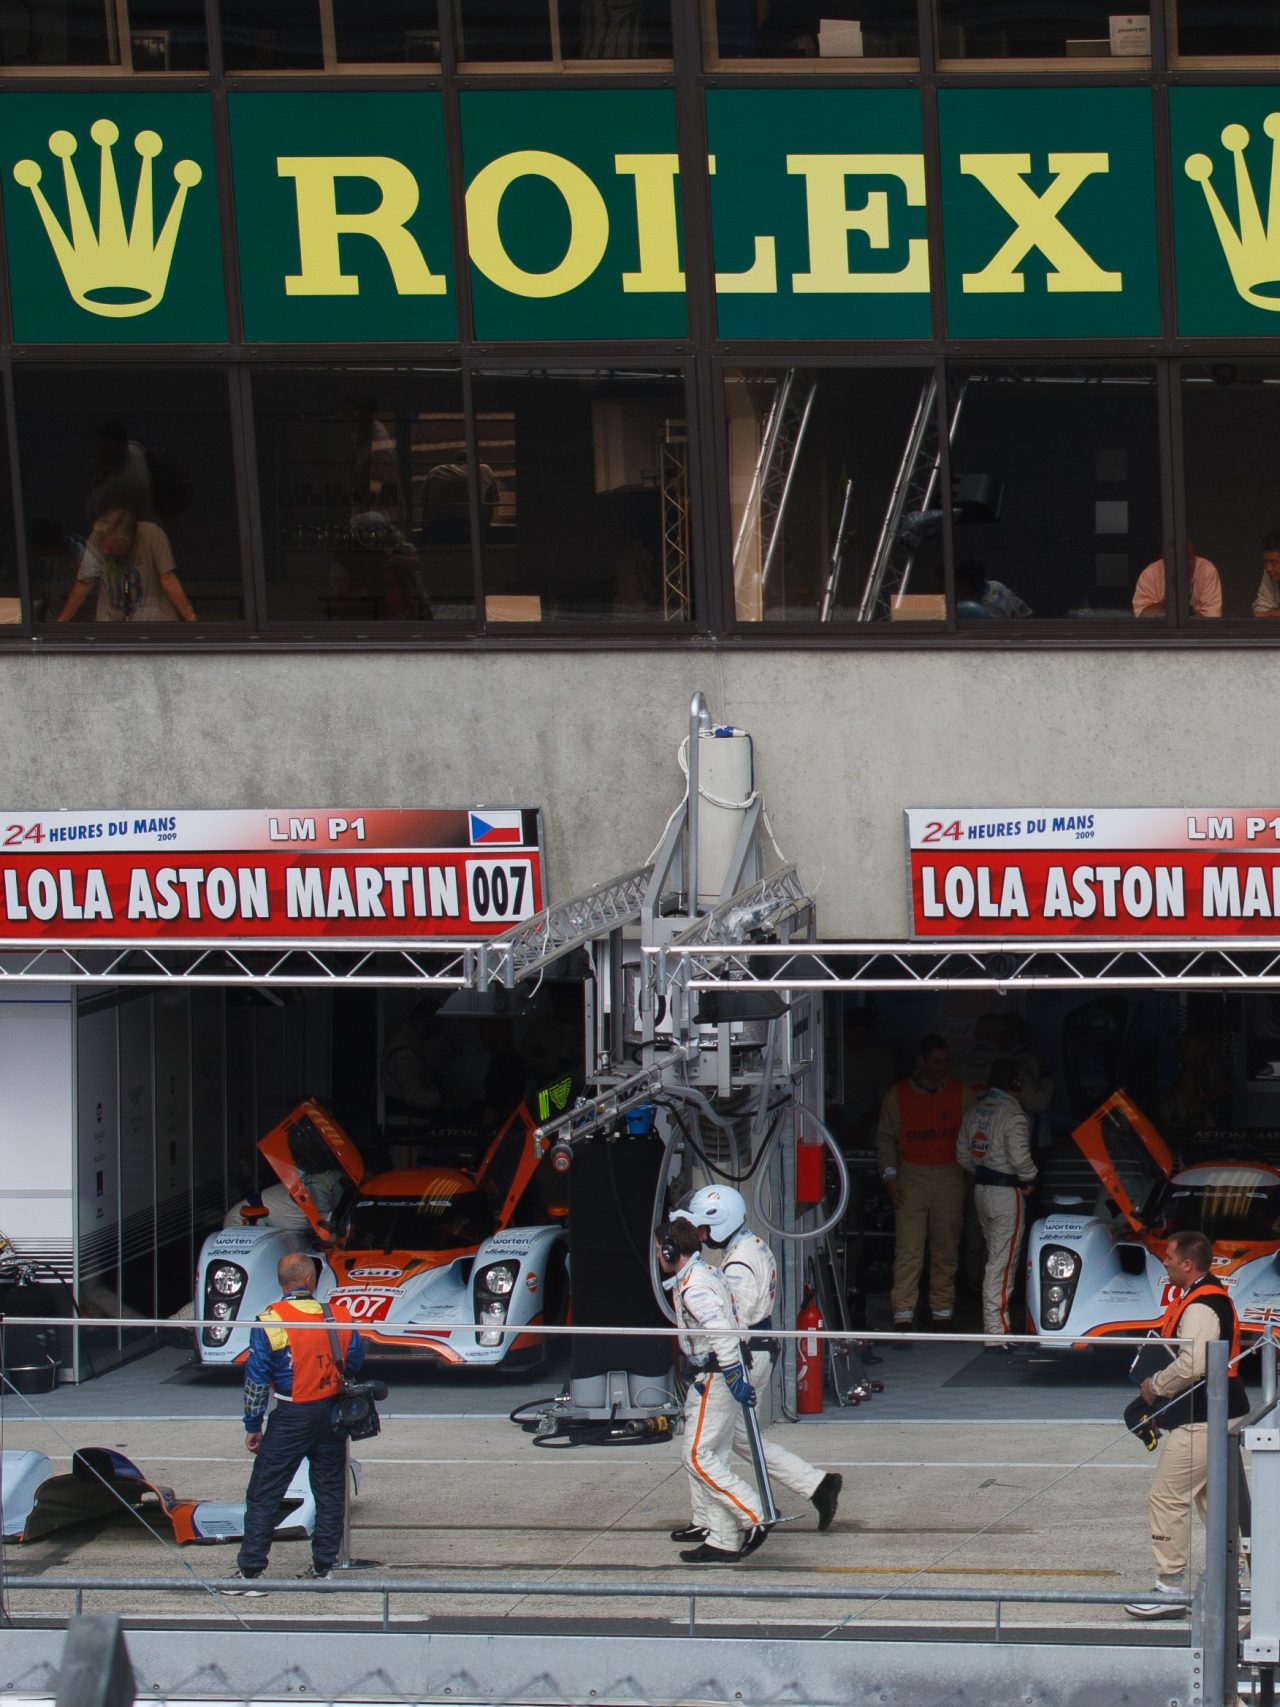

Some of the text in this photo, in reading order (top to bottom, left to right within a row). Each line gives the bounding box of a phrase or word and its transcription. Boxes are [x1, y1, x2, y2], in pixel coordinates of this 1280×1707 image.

[277, 150, 1123, 298] ROLEX
[2, 816, 177, 847] 24 HEURES DU MANS
[157, 832, 177, 842] 2009
[269, 817, 365, 840] LM P1
[921, 814, 1094, 843] 24 HEURES DU MANS
[1075, 830, 1095, 840] 2009
[1187, 817, 1234, 839] LM
[3, 866, 460, 920] LOLA ASTON MARTIN
[472, 865, 527, 917] 007
[921, 865, 1030, 918] LOLA
[1043, 865, 1185, 918] ASTON
